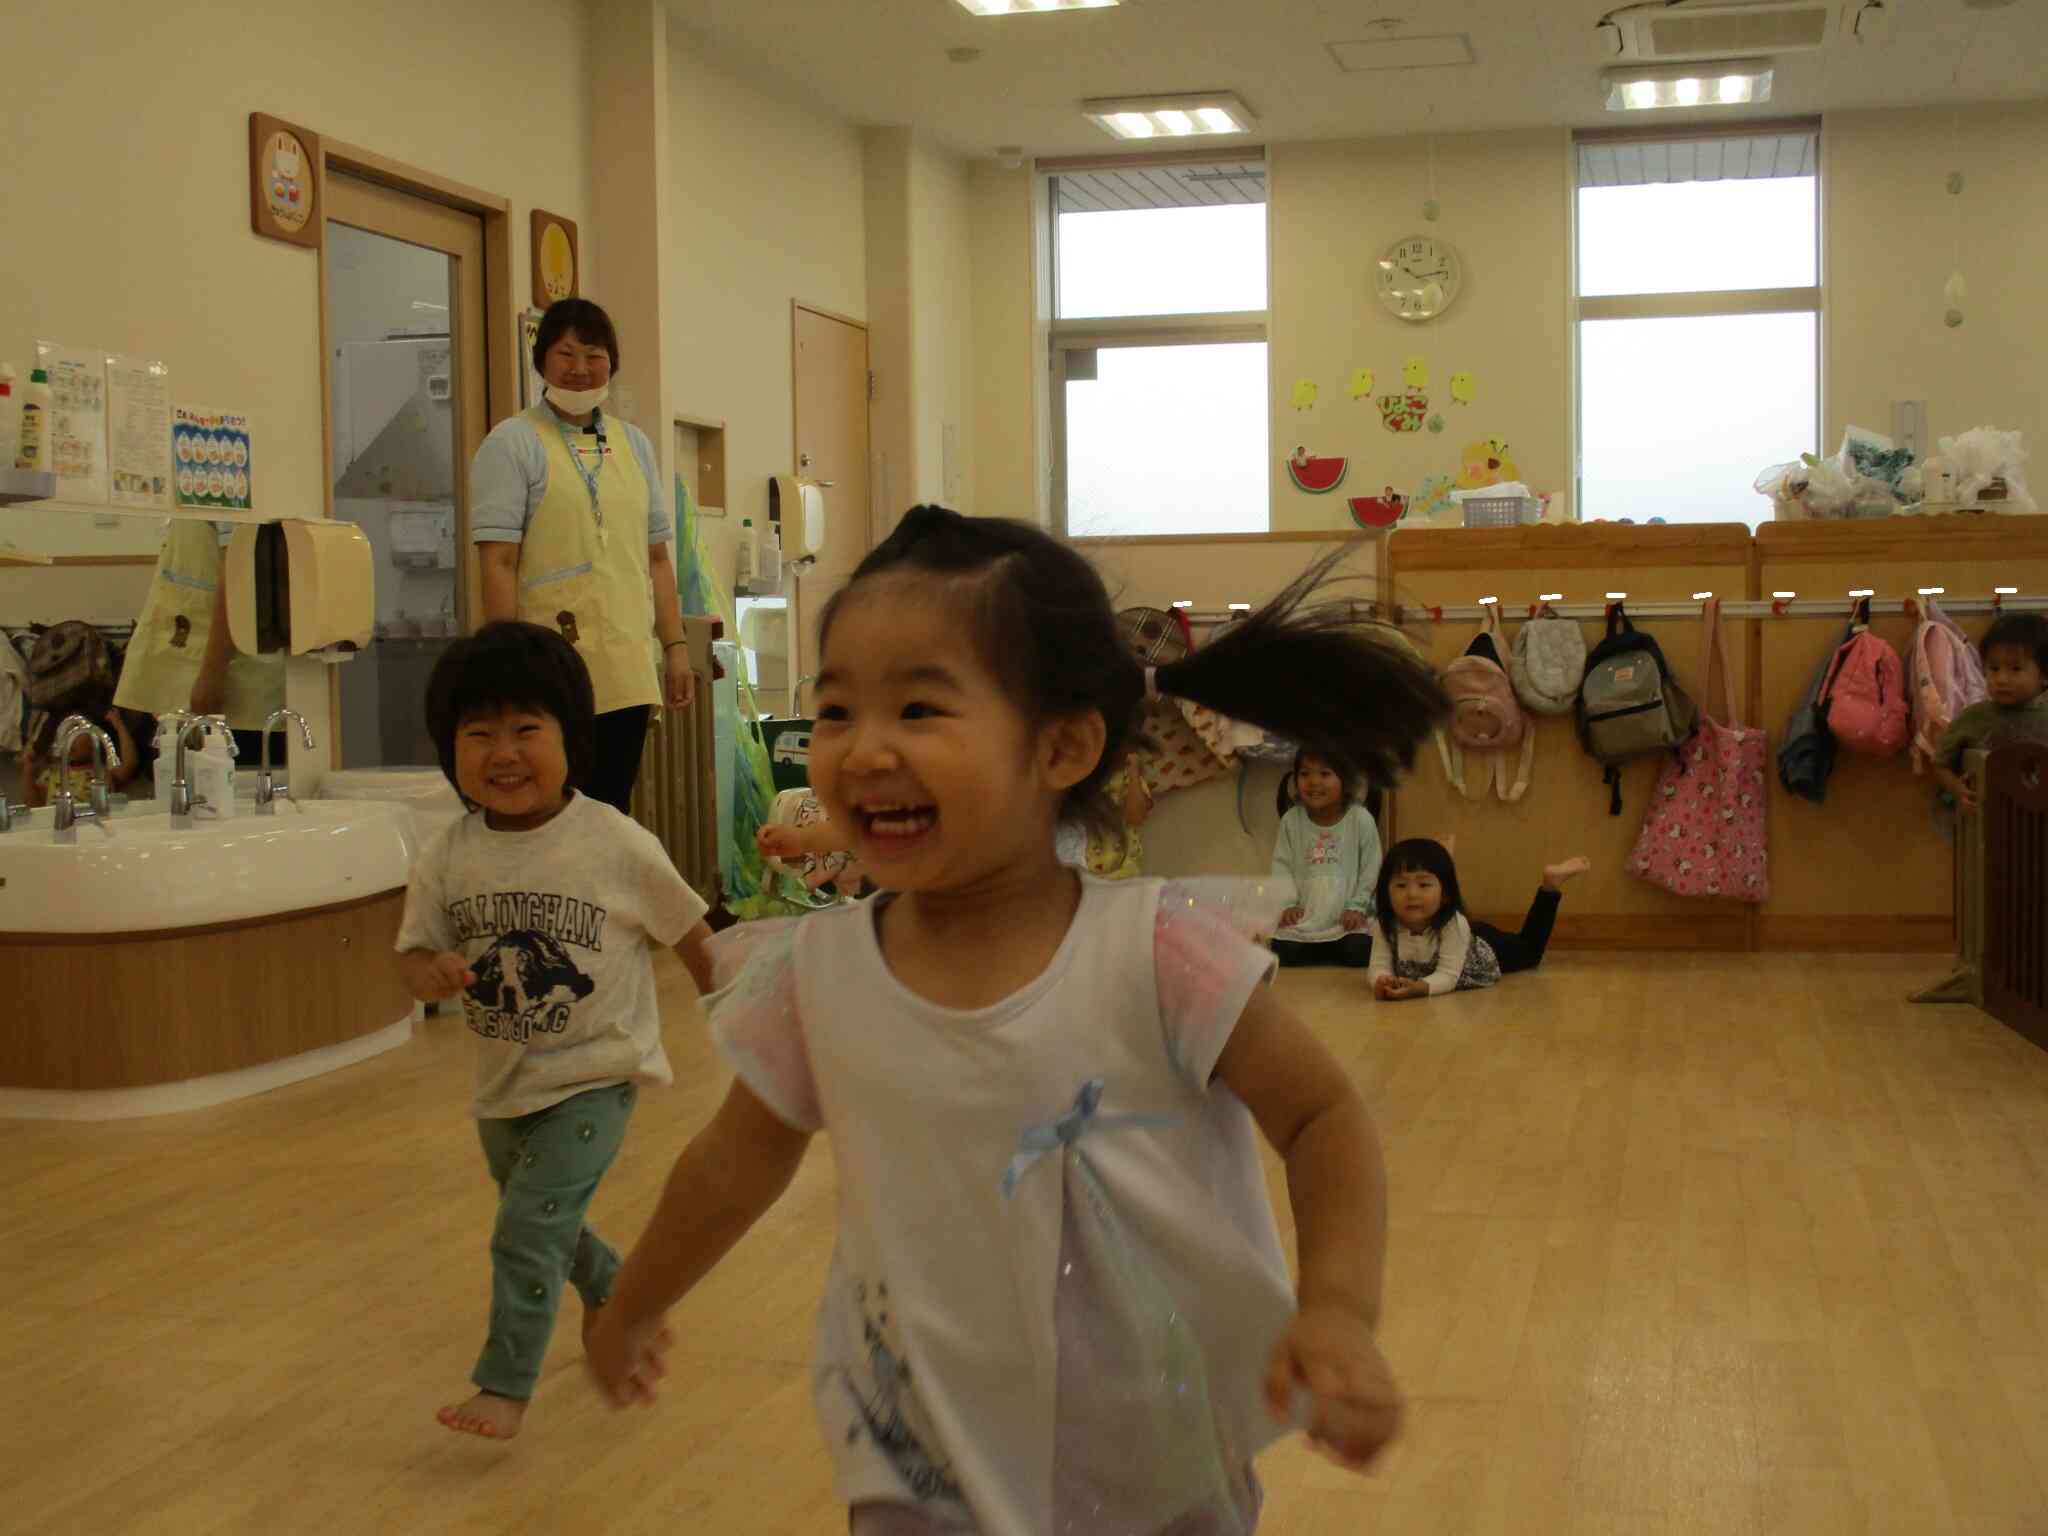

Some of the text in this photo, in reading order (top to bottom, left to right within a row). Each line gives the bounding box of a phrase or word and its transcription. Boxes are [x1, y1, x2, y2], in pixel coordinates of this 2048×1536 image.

[1410, 242, 1424, 254] 12
[1376, 395, 1426, 414] ひよこ
